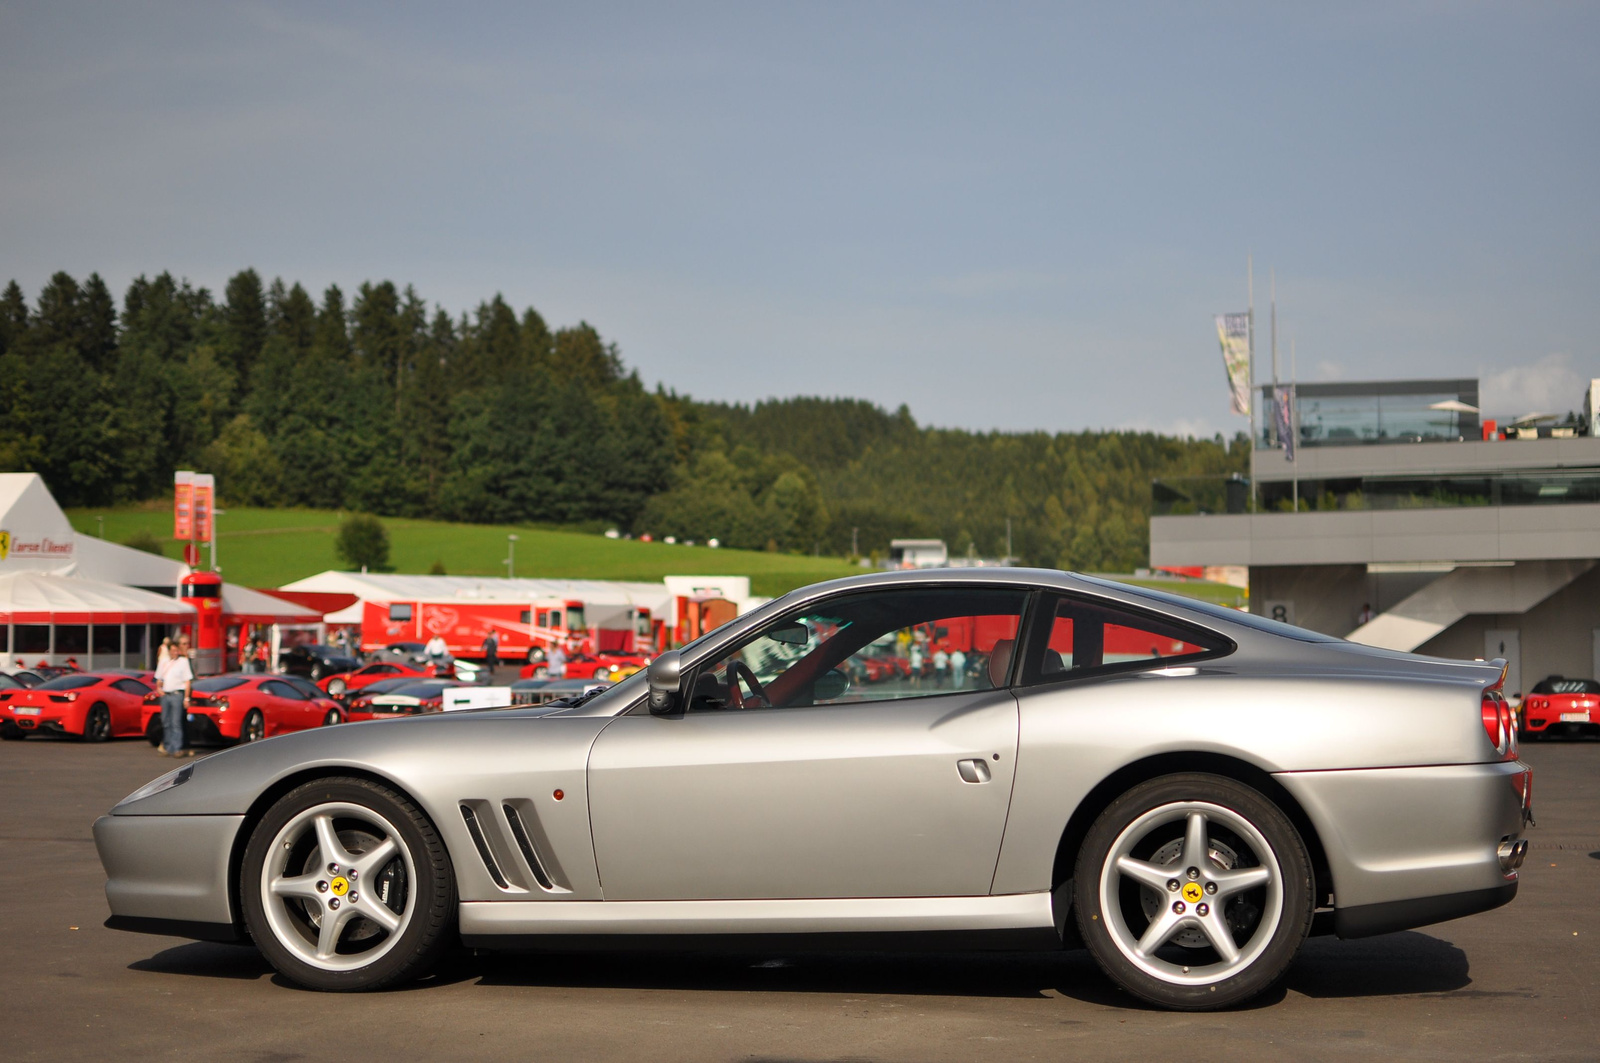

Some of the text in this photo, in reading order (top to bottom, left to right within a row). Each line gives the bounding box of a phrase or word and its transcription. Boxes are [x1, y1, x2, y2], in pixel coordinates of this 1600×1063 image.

[11, 536, 73, 554] Corse Clienti
[1272, 604, 1287, 622] 8
